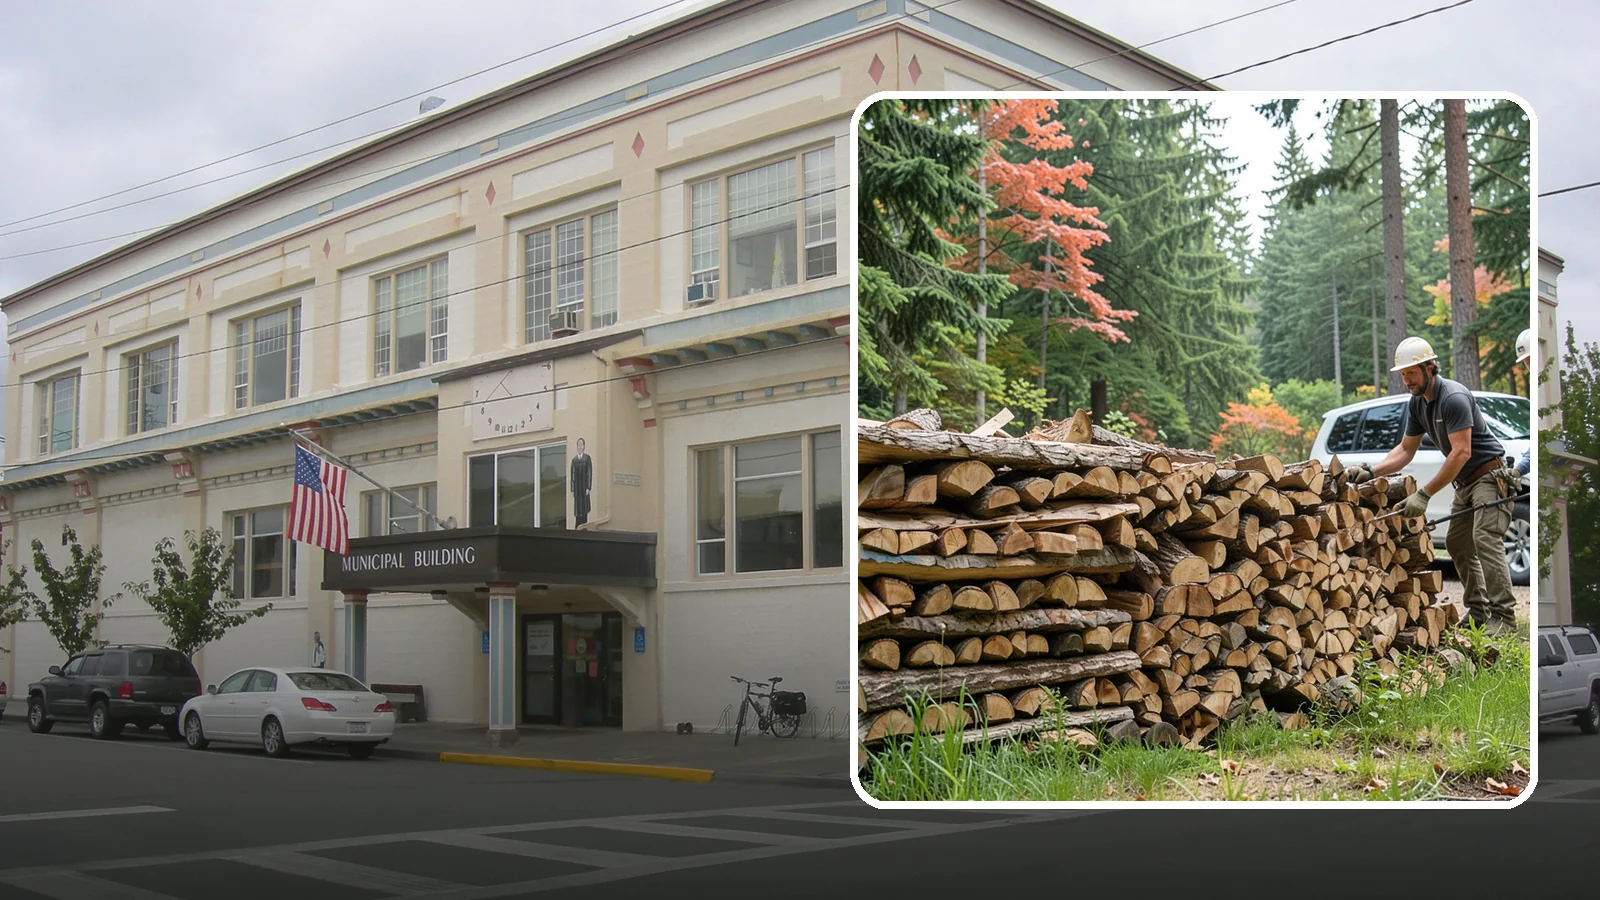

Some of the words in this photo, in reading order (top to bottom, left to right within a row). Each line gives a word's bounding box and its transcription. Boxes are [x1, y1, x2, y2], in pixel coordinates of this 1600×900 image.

[481, 406, 484, 415] 8
[488, 418, 492, 426] 9
[494, 424, 500, 432] 10
[529, 414, 533, 422] 3
[342, 552, 406, 572] MUNICIPAL
[414, 546, 475, 568] BUILDING
